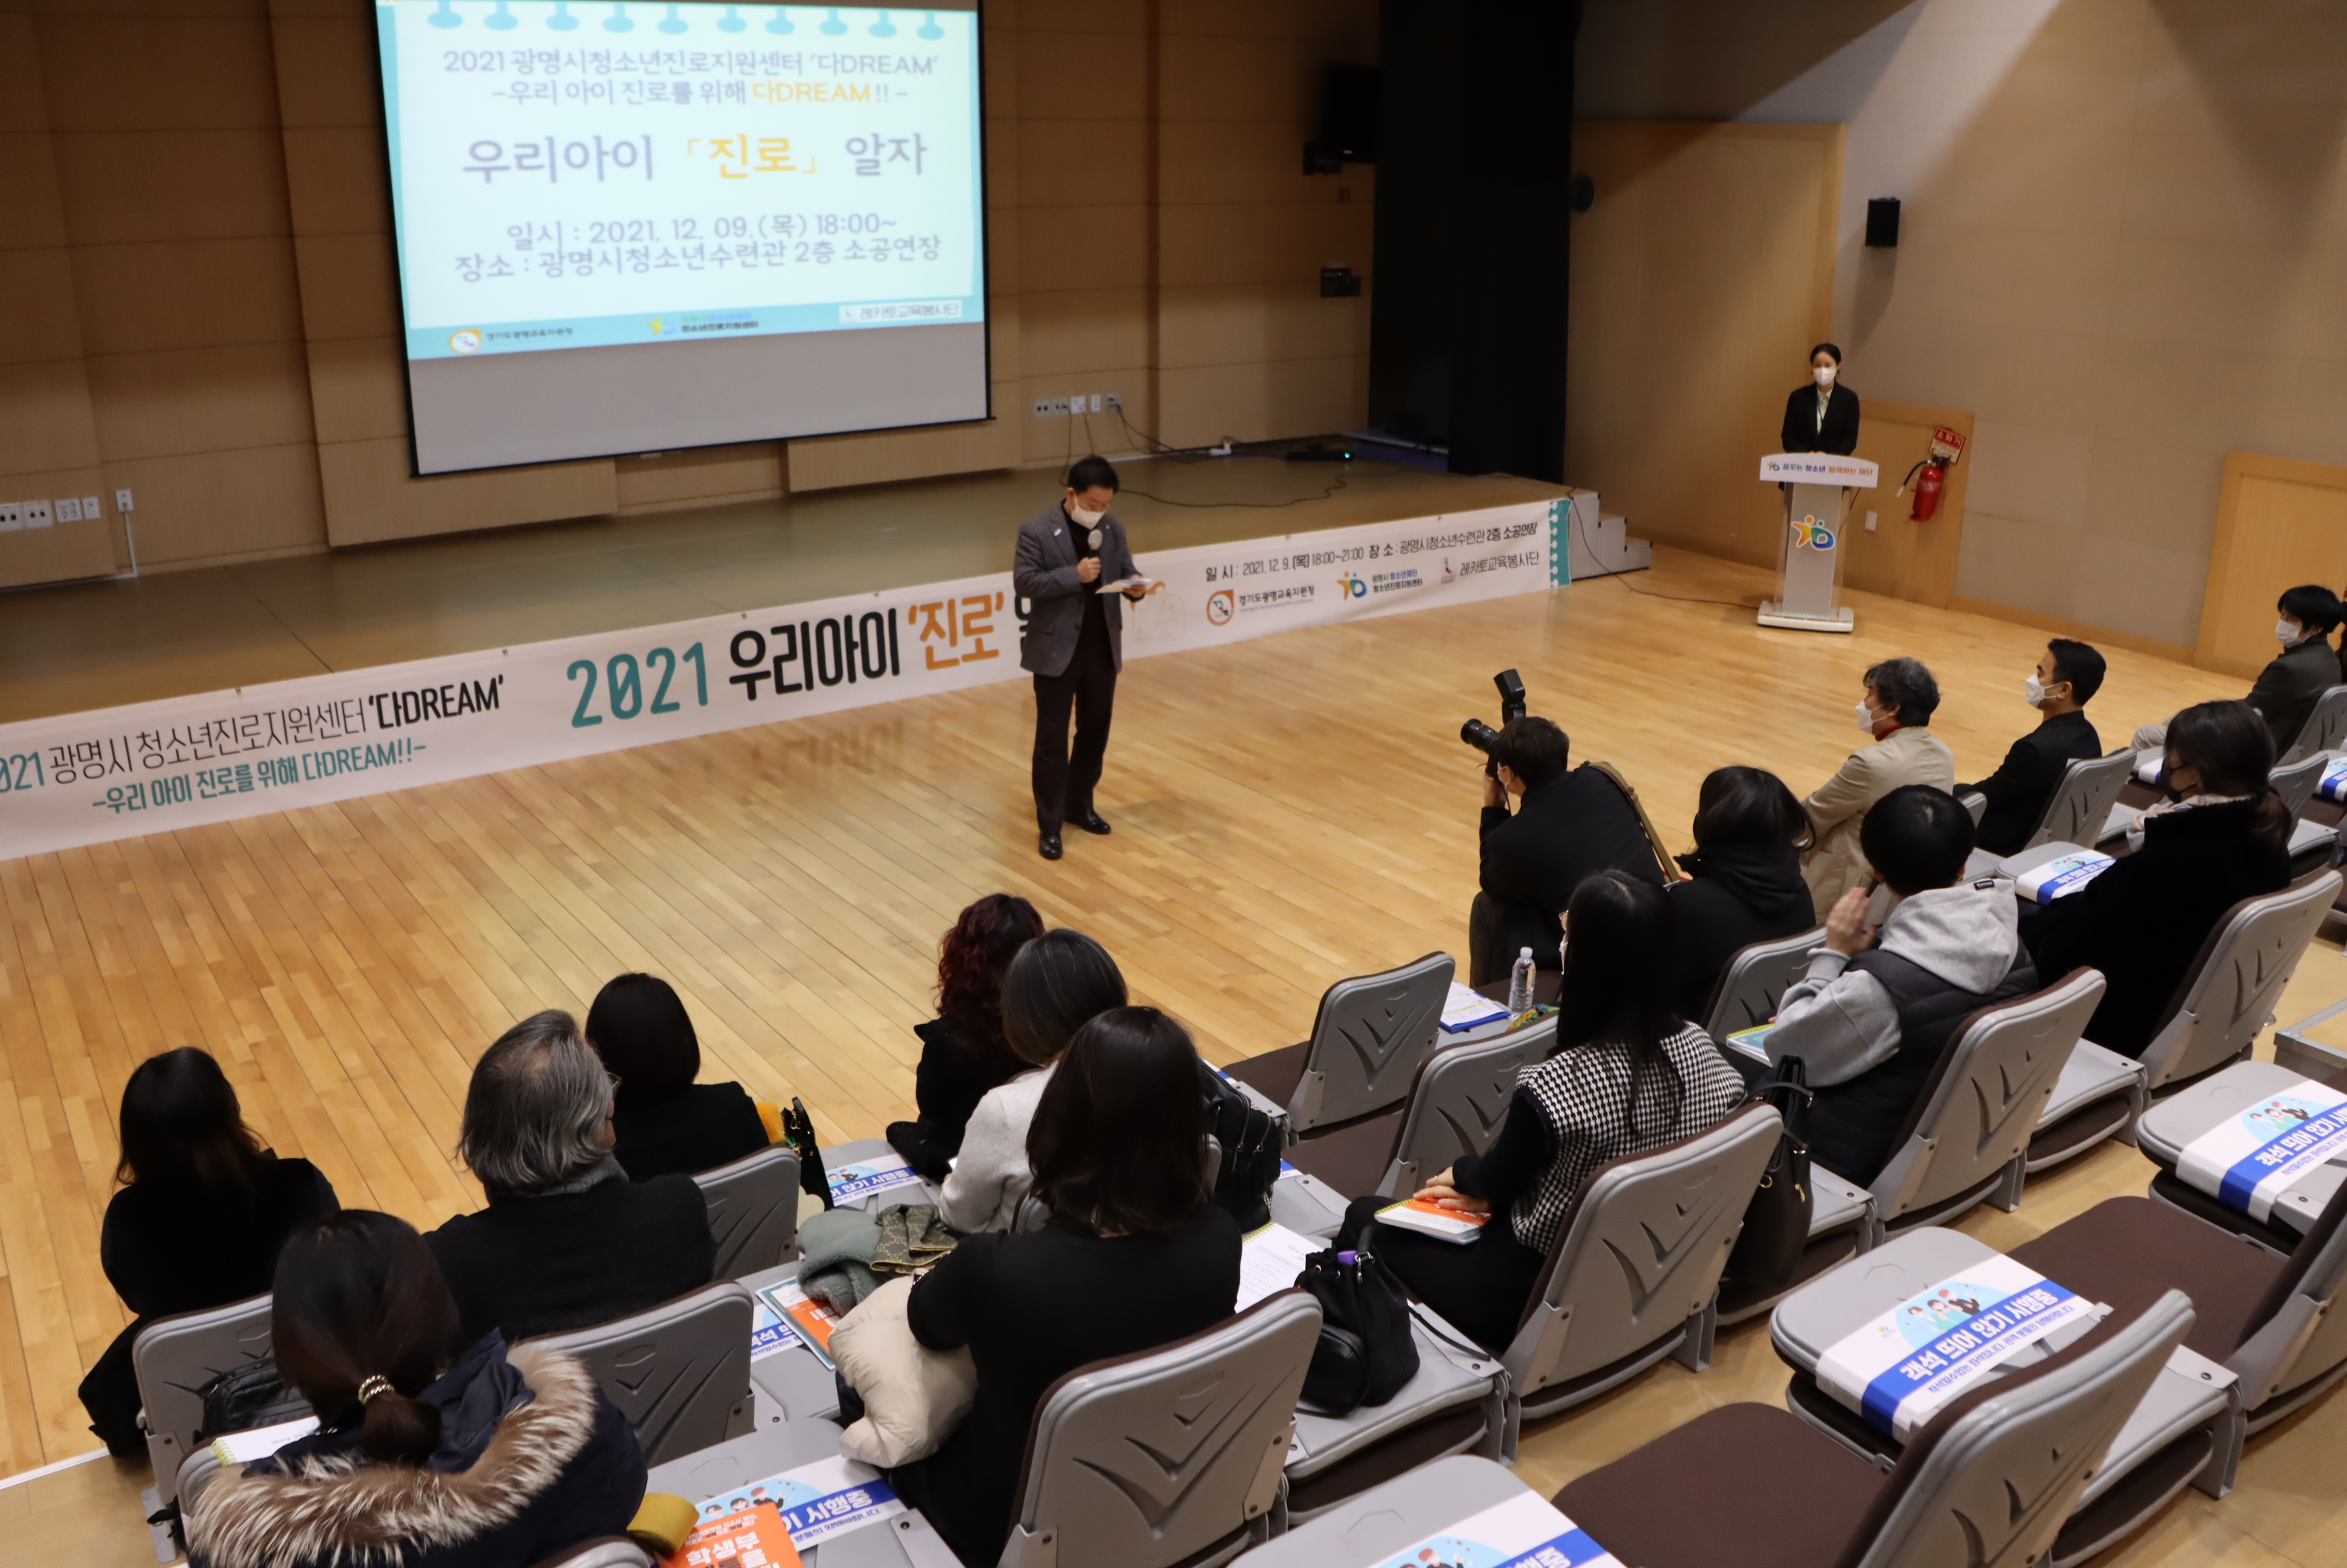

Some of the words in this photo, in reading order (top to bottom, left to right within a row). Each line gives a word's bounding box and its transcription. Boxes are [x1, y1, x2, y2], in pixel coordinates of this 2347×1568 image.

[443, 50, 505, 72] 2021
[510, 48, 803, 76] 광명시청소년진로지원센터
[564, 79, 614, 105] 아이
[620, 79, 694, 105] 진로를
[700, 79, 747, 105] 위해
[463, 134, 654, 185] 우리아이
[845, 132, 927, 178] 알자
[538, 239, 787, 278] 광명시청소년수련관
[794, 240, 836, 265] 2층
[843, 235, 941, 262] 소공연장
[1399, 529, 1486, 555] 광명시청소년수련관
[1486, 527, 1501, 541] 2층
[1503, 522, 1538, 540] 소공연장
[1459, 551, 1540, 577] 레카토교육봉사단
[1238, 585, 1315, 607] 경기도광명교육지원청
[566, 641, 709, 729] 2021
[728, 608, 900, 702] 우리아이
[48, 698, 366, 785] 광명시청소년진로지원센터
[151, 774, 193, 808] 아이
[196, 762, 254, 801] 진로를
[257, 756, 299, 790] 위해
[2254, 1144, 2295, 1167] 객석
[2279, 1129, 2319, 1152] 띄어
[2304, 1117, 2342, 1137] 앉기
[1899, 1350, 1950, 1381] 객석
[1934, 1329, 1983, 1361] 띄어
[1969, 1310, 2016, 1339] 앉기
[2004, 1287, 2059, 1320] 시행중
[806, 1488, 873, 1524] 시행중
[685, 1531, 760, 1567] 학생부
